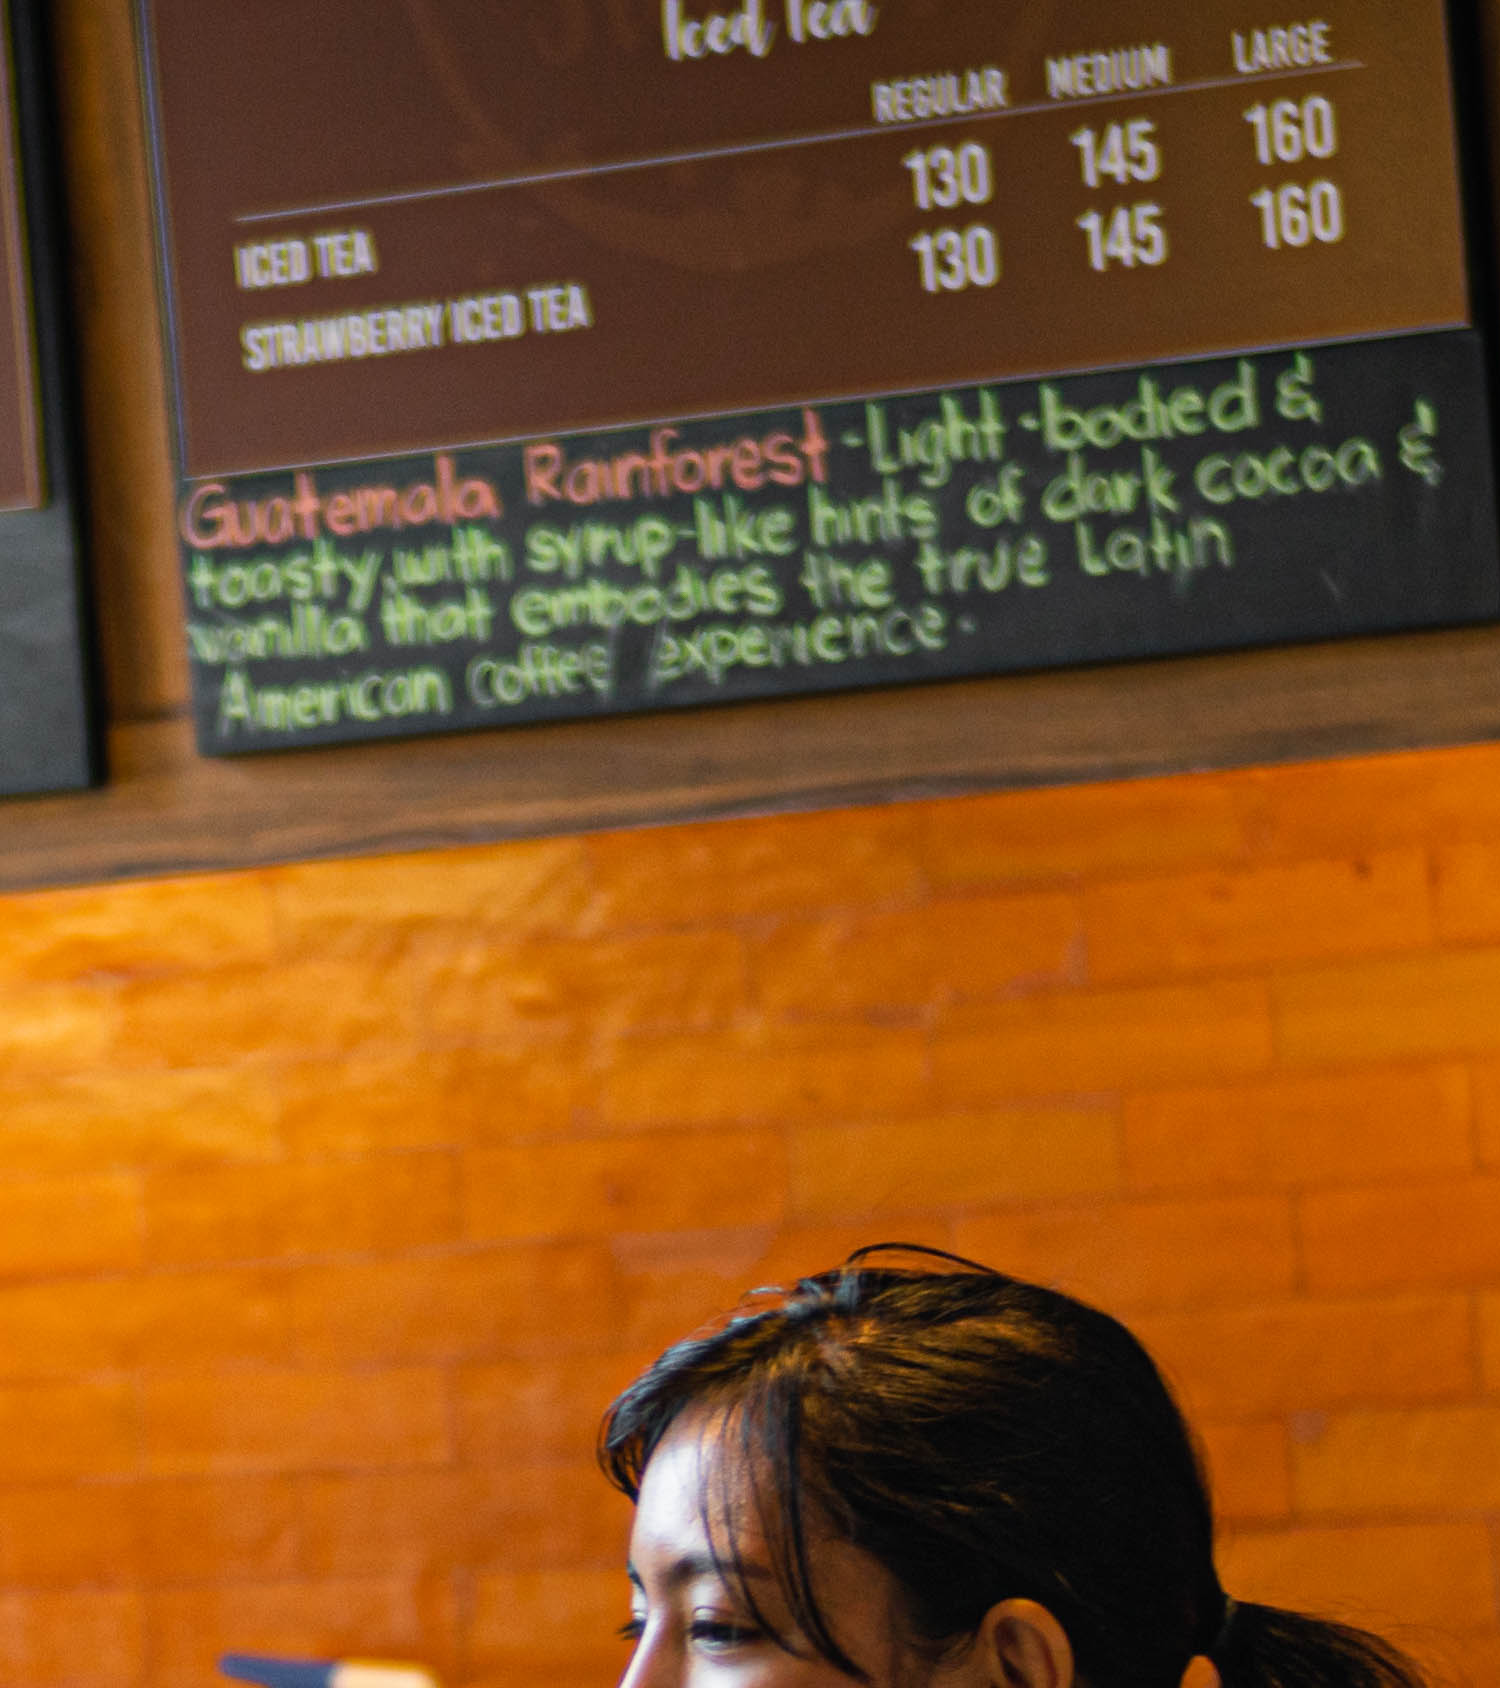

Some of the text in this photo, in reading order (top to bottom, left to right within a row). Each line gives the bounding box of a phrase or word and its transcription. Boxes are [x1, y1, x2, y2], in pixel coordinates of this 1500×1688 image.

[662, 0, 774, 60] Iced
[872, 21, 1334, 125] REGULAR MEDIUM LARGE
[236, 96, 1339, 289] ICED TEA 130 145 160
[243, 180, 1344, 371] STRAWBERRY ICED TEA 130 145 160
[183, 452, 500, 549] Guatemala
[522, 406, 829, 505] Rainforest
[394, 525, 511, 583] with
[809, 482, 937, 546] hints
[964, 464, 1024, 527] of
[1041, 446, 1180, 522] dark
[1194, 437, 1383, 504] cocoa
[187, 601, 368, 662] vanilla
[381, 588, 494, 647] that
[510, 563, 782, 636] embodies
[799, 551, 894, 607] the
[917, 534, 1048, 594] true
[218, 664, 451, 734] American
